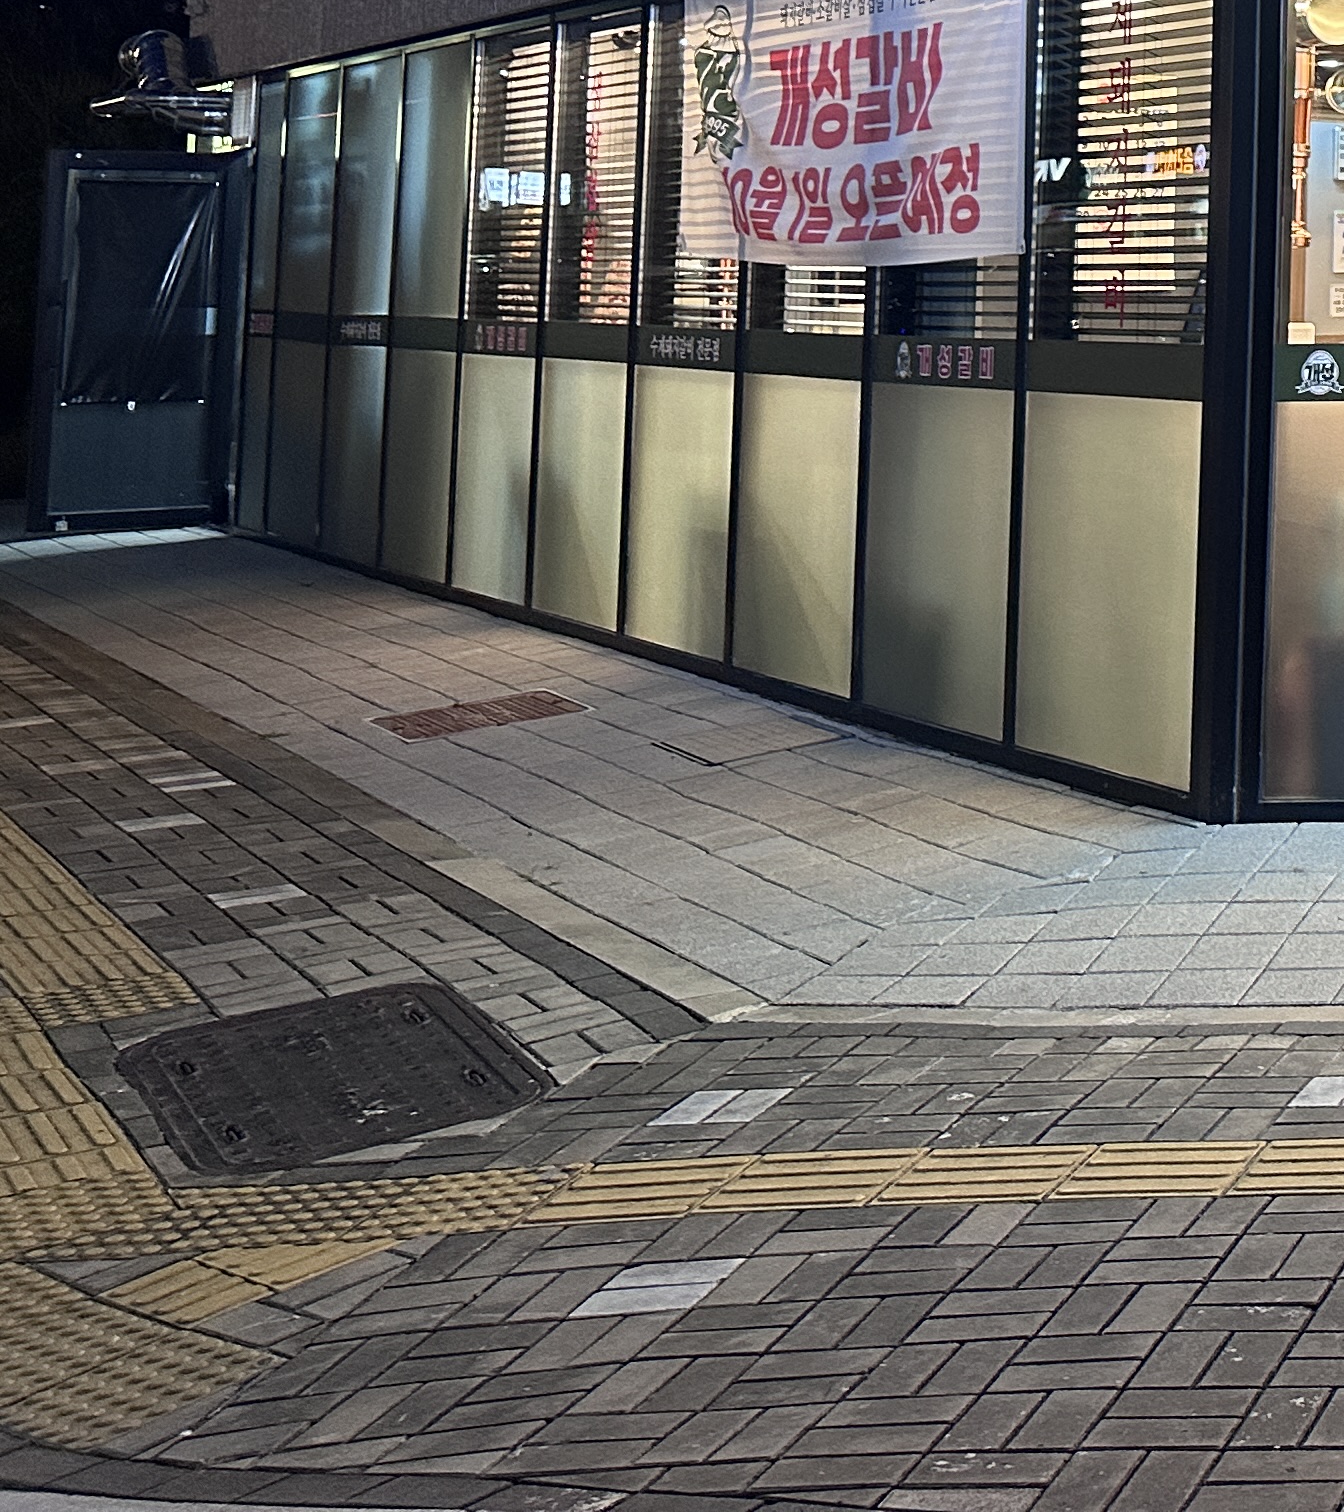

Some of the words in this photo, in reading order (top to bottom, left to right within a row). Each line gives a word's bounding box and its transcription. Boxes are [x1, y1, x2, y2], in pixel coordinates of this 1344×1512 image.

[769, 22, 944, 150] 개성갈비
[721, 165, 788, 242] 10월
[787, 166, 833, 244] 1일
[836, 142, 980, 244] 오픈예정
[916, 343, 995, 380] 개성갈비
